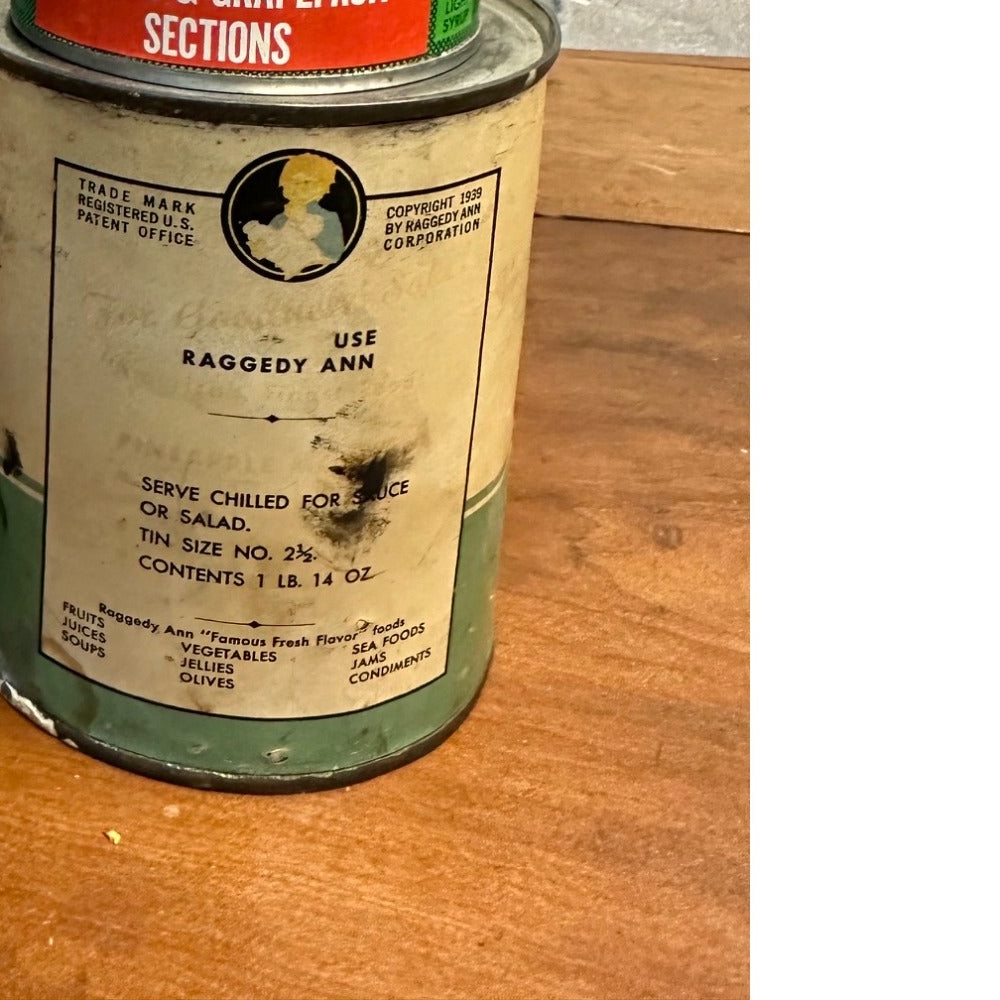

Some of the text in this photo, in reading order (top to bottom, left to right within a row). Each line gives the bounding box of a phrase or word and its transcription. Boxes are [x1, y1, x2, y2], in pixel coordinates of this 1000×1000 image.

[143, 12, 292, 66] SECTIONS
[78, 193, 194, 231] REGISTERED U.S.
[79, 178, 196, 215] TRADE MARK
[386, 186, 483, 219] COPYRIGHT 1939
[77, 209, 194, 247] PATENT OFFICE
[383, 218, 480, 251] CORPORATION
[385, 202, 481, 236] BY RAGGEDY ANN
[333, 329, 377, 349] USE
[182, 349, 375, 374] RAGGEDY ANN
[141, 476, 410, 510] SERVE CHILLED FOR SUCE
[139, 500, 251, 533] OR SALAD.
[138, 527, 170, 548] TIN
[181, 537, 223, 557] SIZE
[234, 544, 273, 561] NO.
[138, 555, 245, 587] CONTENTS
[257, 574, 265, 588] 1
[278, 574, 302, 588] LB.
[313, 572, 333, 588] 14
[62, 616, 107, 644] JUICES
[63, 601, 105, 629] FRUITS
[98, 602, 160, 633] Raggedy
[164, 625, 194, 639] Ann
[272, 636, 309, 648] Fresh
[372, 618, 405, 635] foods
[61, 630, 106, 659] SOUPS
[181, 642, 277, 663] VEGETABLES
[351, 622, 426, 655] SEA FOODS
[180, 657, 234, 675] JELLIES
[349, 647, 432, 685] CONDIMENTS
[350, 651, 387, 670] JAMS
[179, 672, 235, 690] OLIVES
